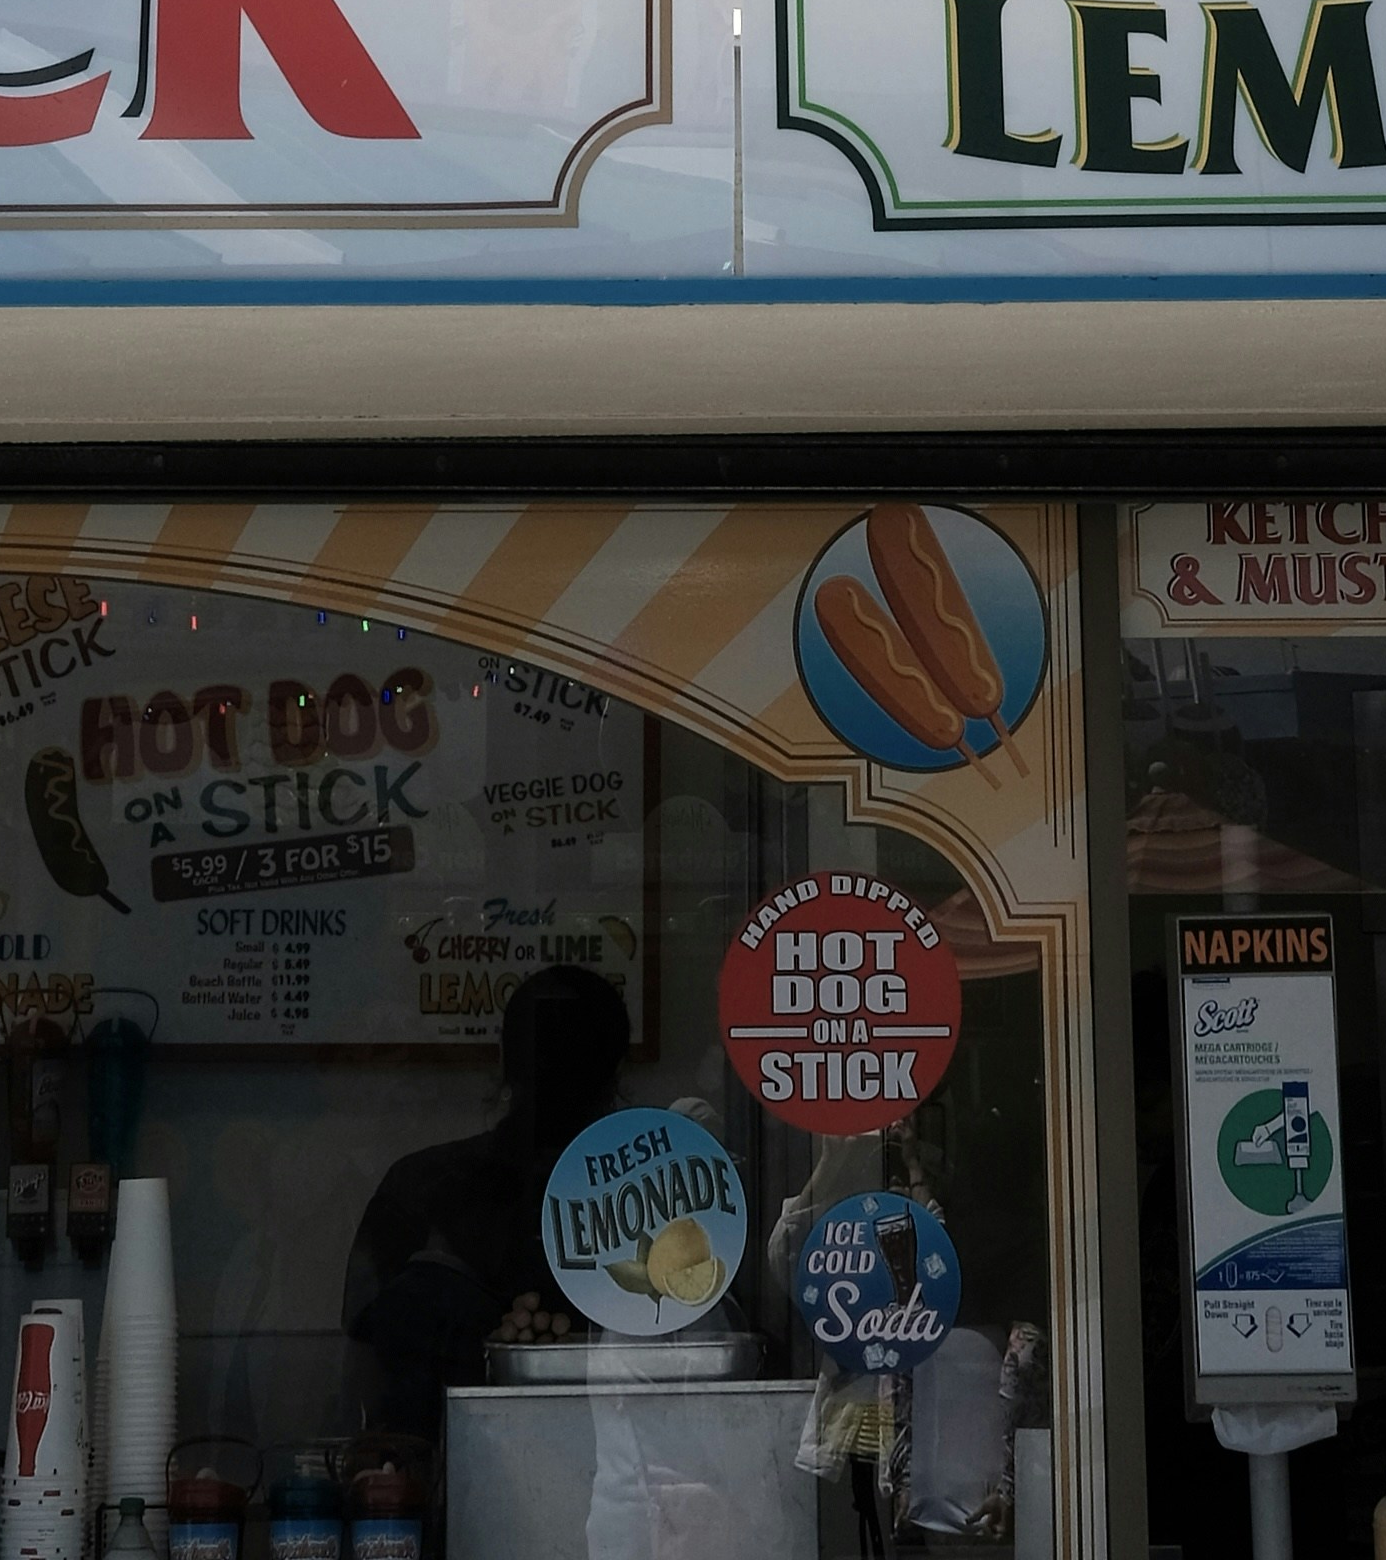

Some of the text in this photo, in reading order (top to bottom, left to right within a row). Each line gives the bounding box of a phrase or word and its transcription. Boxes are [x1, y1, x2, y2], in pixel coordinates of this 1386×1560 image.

[1166, 552, 1224, 607] &
[479, 657, 500, 670] ON
[79, 666, 441, 786] HOT DOG
[514, 702, 551, 726] $7.49
[124, 761, 429, 838] ON STICK
[484, 771, 624, 805] VEGGIE DOG
[491, 799, 620, 828] ON STICK
[150, 822, 176, 848] A
[171, 854, 229, 880] $5.99
[257, 848, 278, 877] 3
[285, 844, 341, 873] FOR
[346, 833, 392, 865] $15
[197, 908, 347, 936] SOFT DRINKS
[484, 897, 557, 932] Fresh
[740, 874, 941, 951] HAND DIPPED
[438, 935, 604, 963] CHERRY OR LIME
[774, 931, 906, 972] HOT
[1183, 927, 1329, 966] NAPKINS
[228, 991, 263, 1004] Water
[771, 973, 908, 1015] DOG
[228, 1008, 261, 1021] Juice
[813, 1018, 870, 1045] ON A
[1193, 997, 1259, 1037] Scott
[1223, 1042, 1275, 1053] CARTRIDGE
[759, 1050, 919, 1101] STICK
[584, 1125, 673, 1187] FRESH
[547, 1154, 737, 1271] LEMONADE
[823, 1221, 868, 1246] ICE
[807, 1250, 876, 1275] COLD
[813, 1280, 945, 1344] Soda
